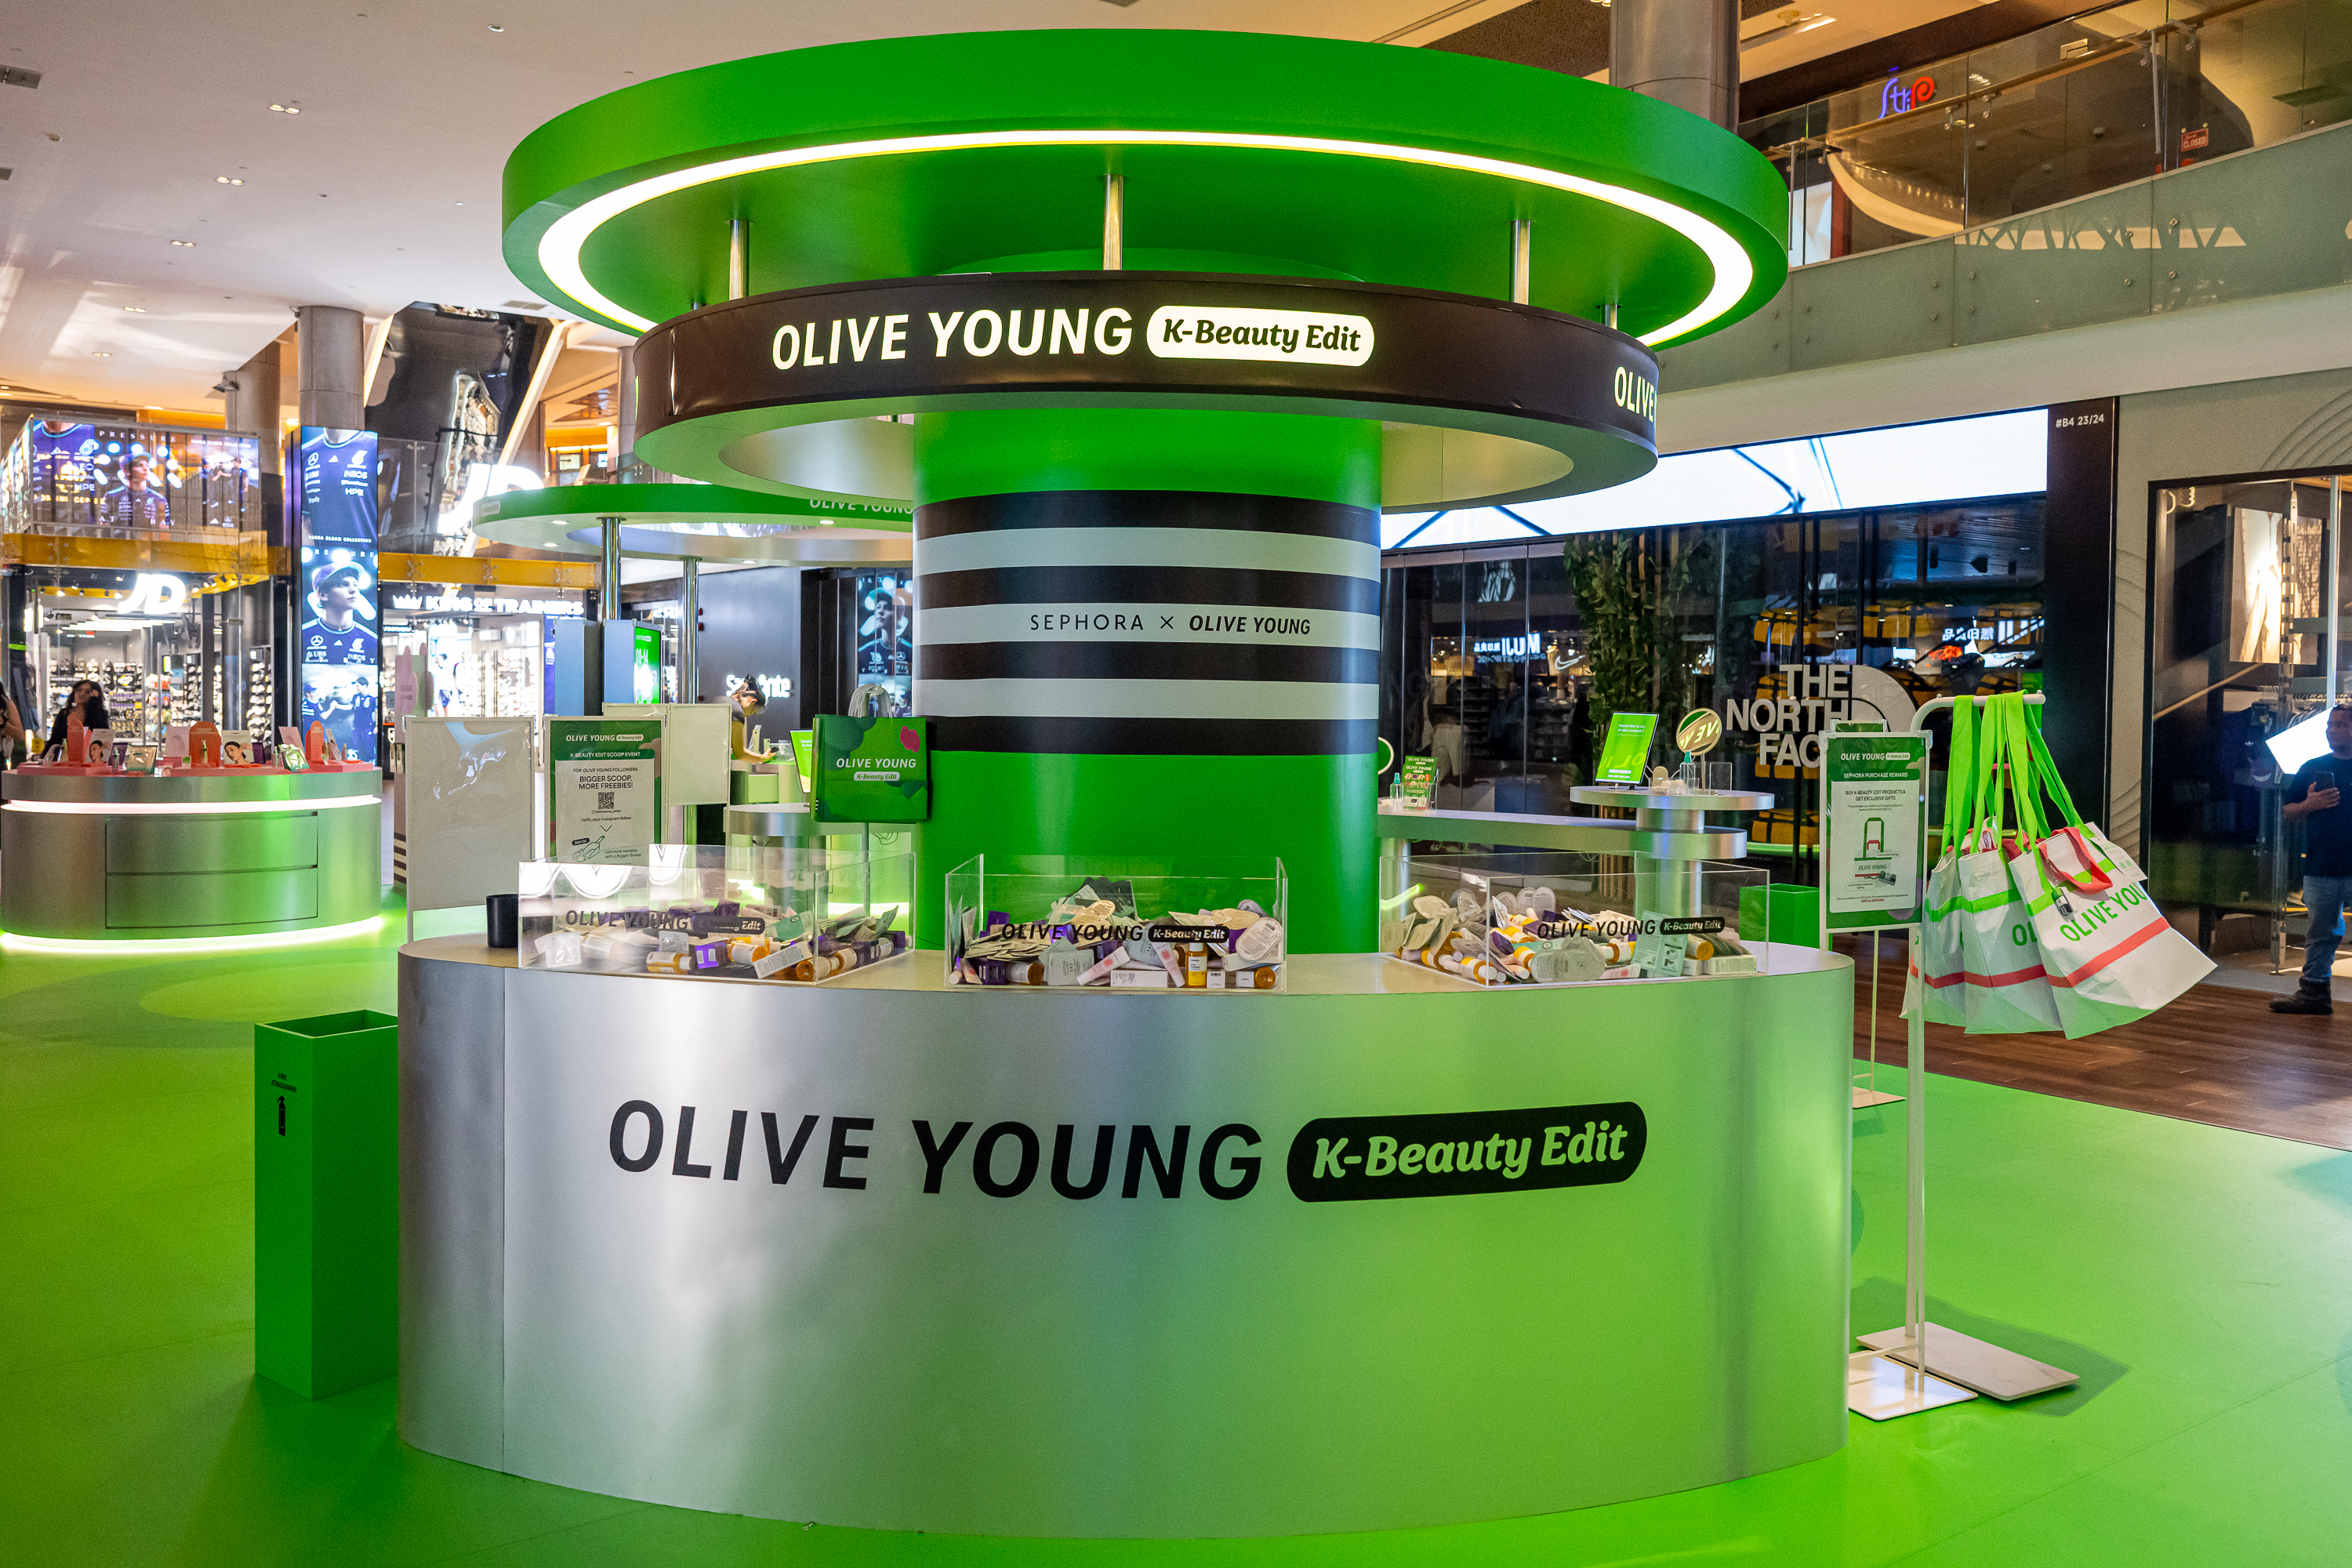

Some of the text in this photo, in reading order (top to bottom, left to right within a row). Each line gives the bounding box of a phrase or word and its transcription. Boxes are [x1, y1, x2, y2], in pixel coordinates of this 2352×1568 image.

[2183, 136, 2206, 149] CLOSED
[771, 307, 1361, 370] OLIVE YOUNG K-Beauty Edit
[1614, 366, 1654, 423] OLIVE
[2056, 413, 2104, 428] #B4 23/24
[343, 470, 368, 480] INEOS
[345, 488, 365, 496] HPE
[118, 573, 187, 615] JD
[426, 596, 474, 612] KING
[494, 598, 584, 615] TRAINERS
[1030, 614, 1143, 630] SEPHORA
[1189, 615, 1247, 633] OLIVE
[1254, 616, 1311, 635] YOUNG
[1780, 665, 1849, 698] THE
[1726, 699, 1849, 732] NORTH
[1759, 733, 1820, 769] FAC
[837, 758, 916, 768] OLIVE YOUNG
[565, 909, 619, 928] OLIVE
[626, 910, 688, 931] YOUNG
[742, 920, 762, 931] Edit
[2060, 901, 2118, 942] OLIVE
[2110, 882, 2147, 912] YOU
[1002, 923, 1225, 941] OLIVE YOUNG K-Beauty Edit
[1537, 920, 1722, 939] OLIVE YOUNG K-Beauty Edit
[608, 1100, 1628, 1201] OLIVE YOUNG K-Beauty Edit
